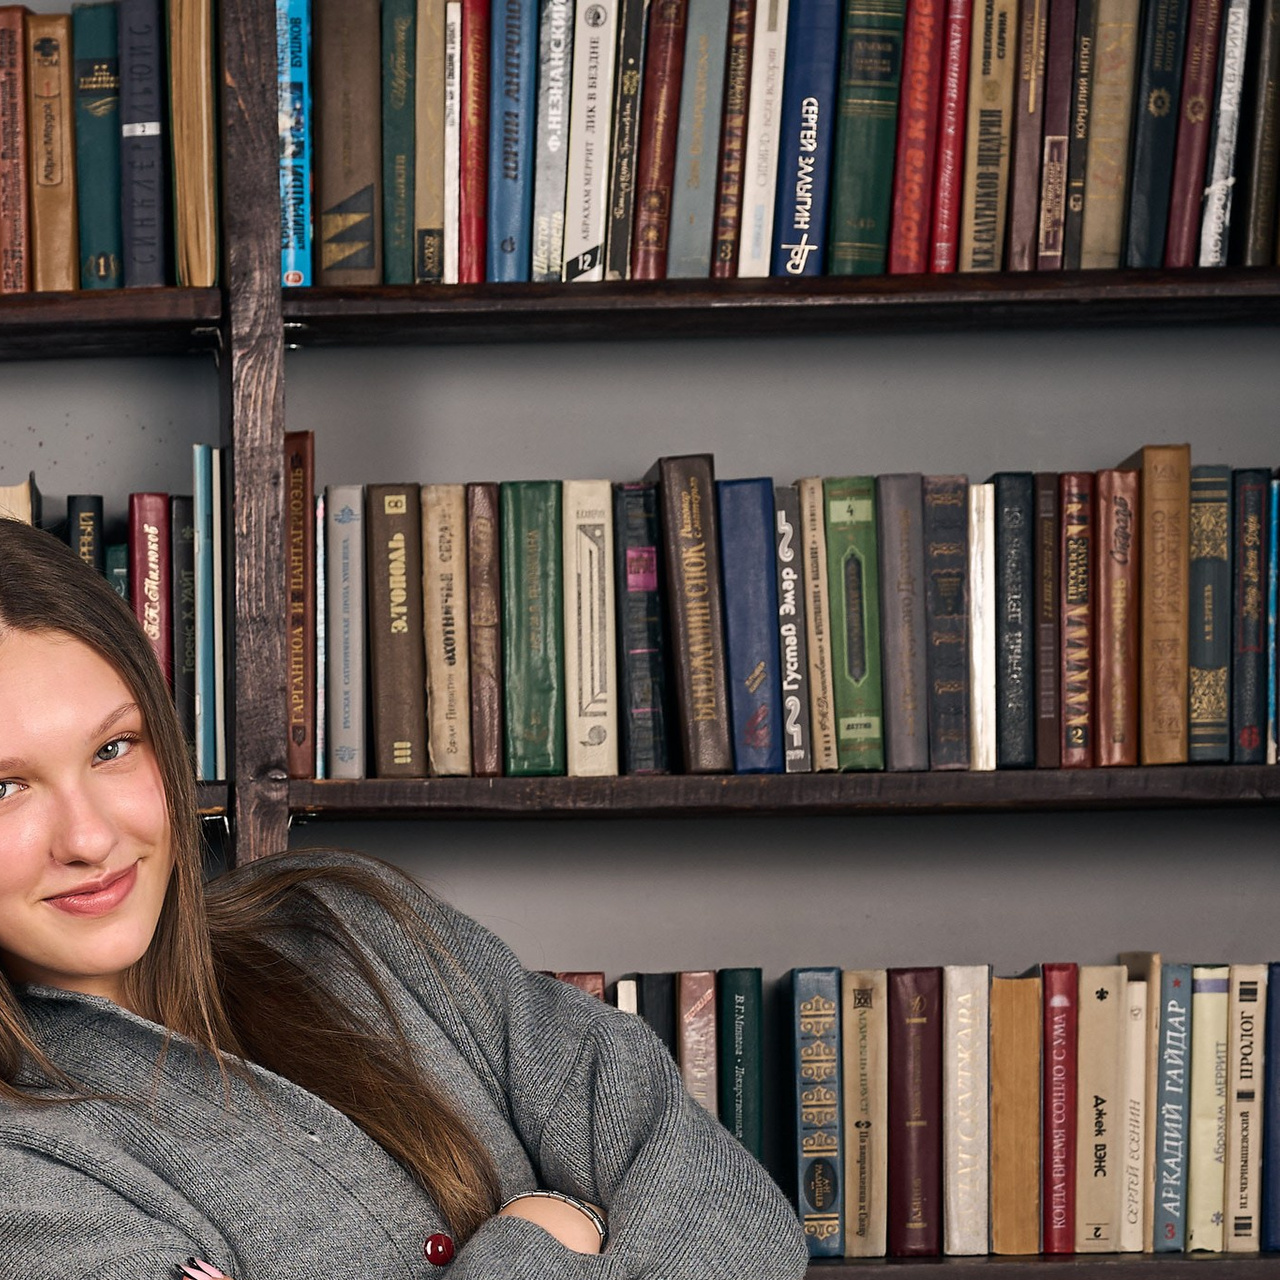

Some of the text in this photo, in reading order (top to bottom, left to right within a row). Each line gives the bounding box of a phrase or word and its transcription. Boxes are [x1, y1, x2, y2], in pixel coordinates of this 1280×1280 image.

[290, 17, 304, 69] БУШКОВ
[996, 10, 1008, 60] СТАРИНА
[1076, 36, 1091, 139] КОРНЕЛИЙ НЕПОТ
[1224, 9, 1242, 108] АКВАРИУМ
[290, 467, 305, 724] ГАРГАНТЮА И ПАНТАГРЮЭЛЬ
[682, 542, 717, 721] БЕНДЖАМИН СПОК
[779, 567, 802, 691] Густав Эмар
[1213, 1040, 1227, 1164] Абрахам МЕРРИТТ
[1239, 1011, 1255, 1080] ПРОЛОГ
[1051, 1013, 1067, 1230] КОГДА ВРЕМЯ СОШЛО С УМА
[1092, 1095, 1108, 1178] Джек ВЭНС
[1126, 1099, 1142, 1225] СЕРГЕЙ ЕСЕНИН
[1161, 999, 1186, 1218] АРКАДИЙ ГАЙДАР
